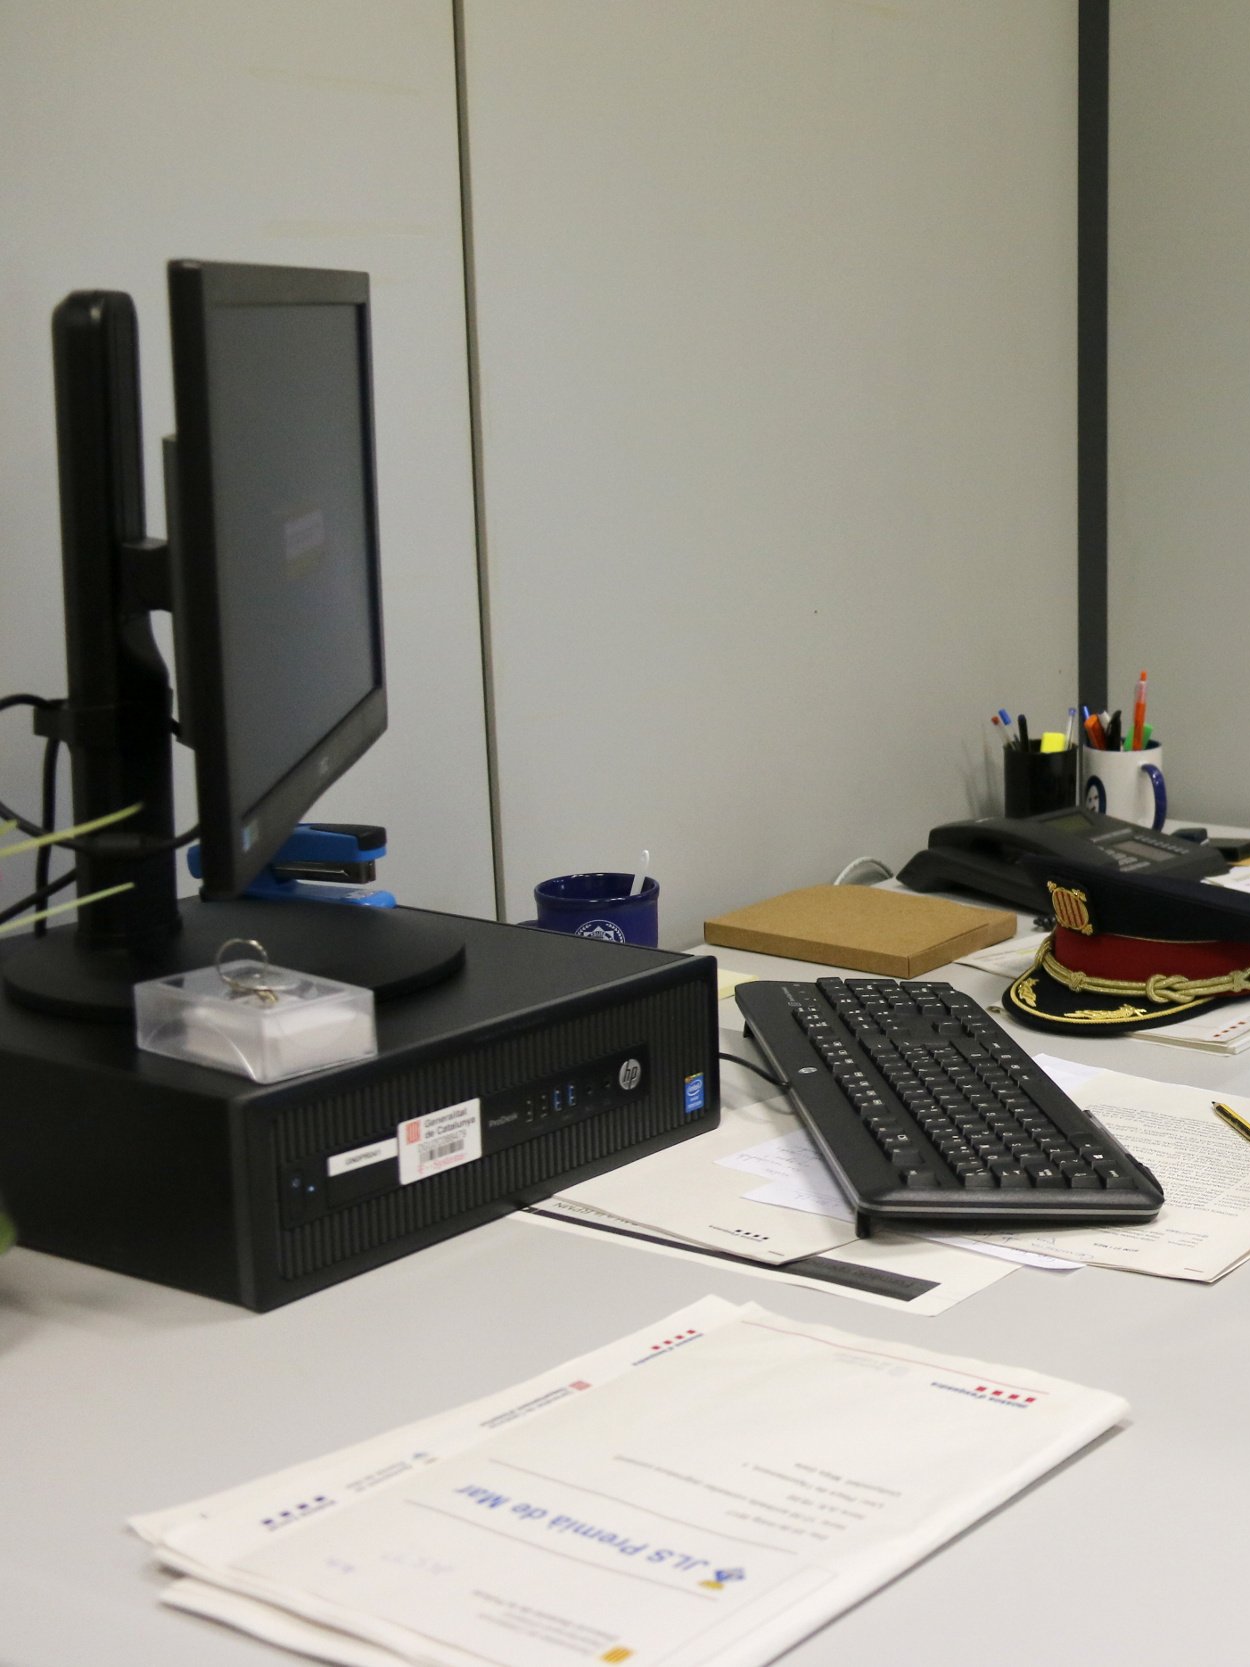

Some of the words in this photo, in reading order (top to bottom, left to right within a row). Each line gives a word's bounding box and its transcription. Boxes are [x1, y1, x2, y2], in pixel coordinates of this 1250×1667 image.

[621, 1060, 639, 1090] hp
[453, 1484, 511, 1509] Mar
[511, 1502, 549, 1520] de
[646, 1548, 711, 1571] JLS
